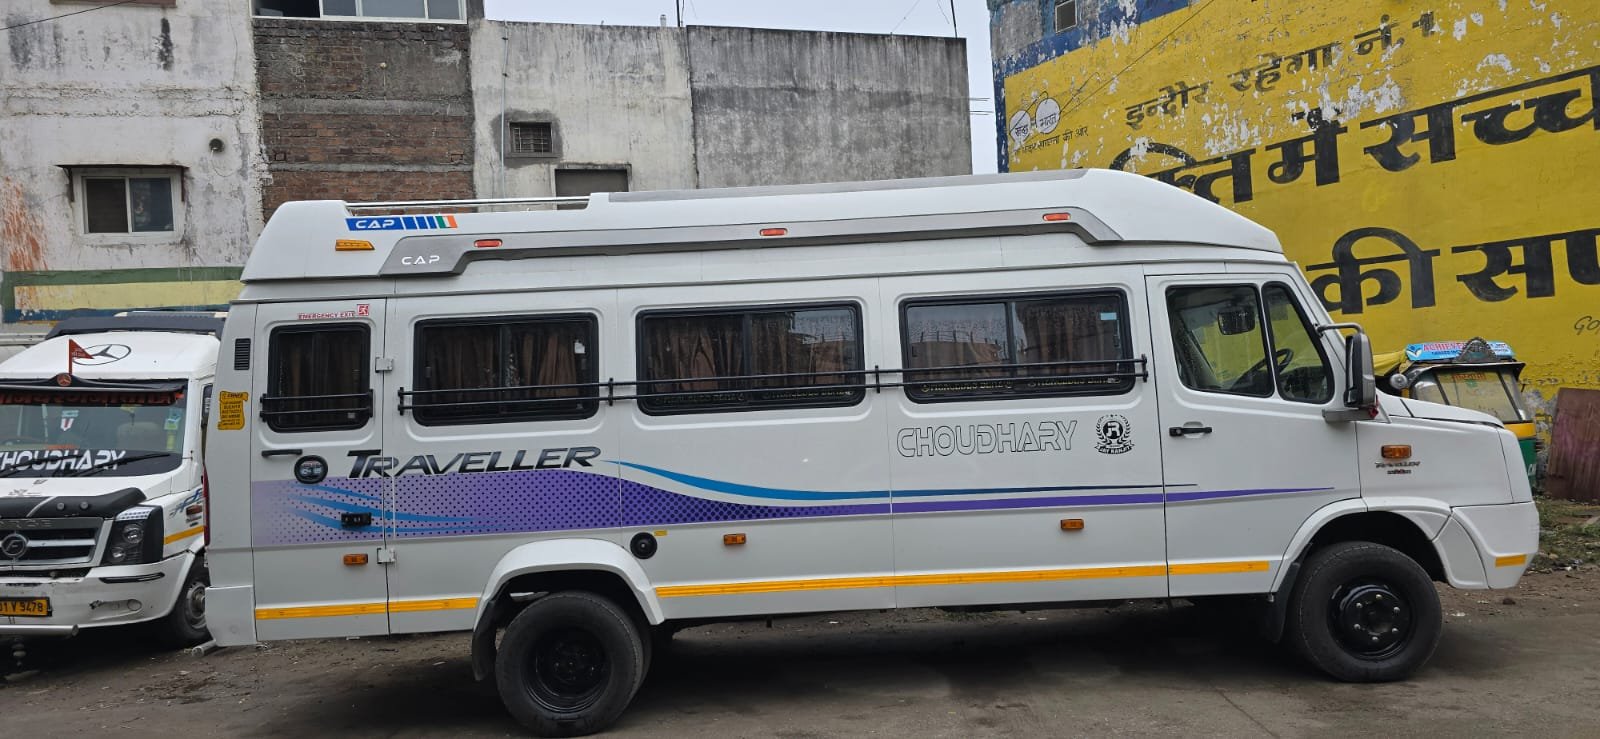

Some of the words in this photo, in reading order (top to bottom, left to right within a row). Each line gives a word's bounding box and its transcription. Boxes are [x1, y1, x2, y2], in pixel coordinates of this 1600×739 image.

[355, 219, 395, 229] CAP
[401, 254, 440, 265] CAP
[1305, 226, 1440, 315] की
[897, 420, 1078, 458] CHOUDHARY
[0, 450, 126, 471] HOUDHARY
[346, 446, 602, 479] TRAVELLER
